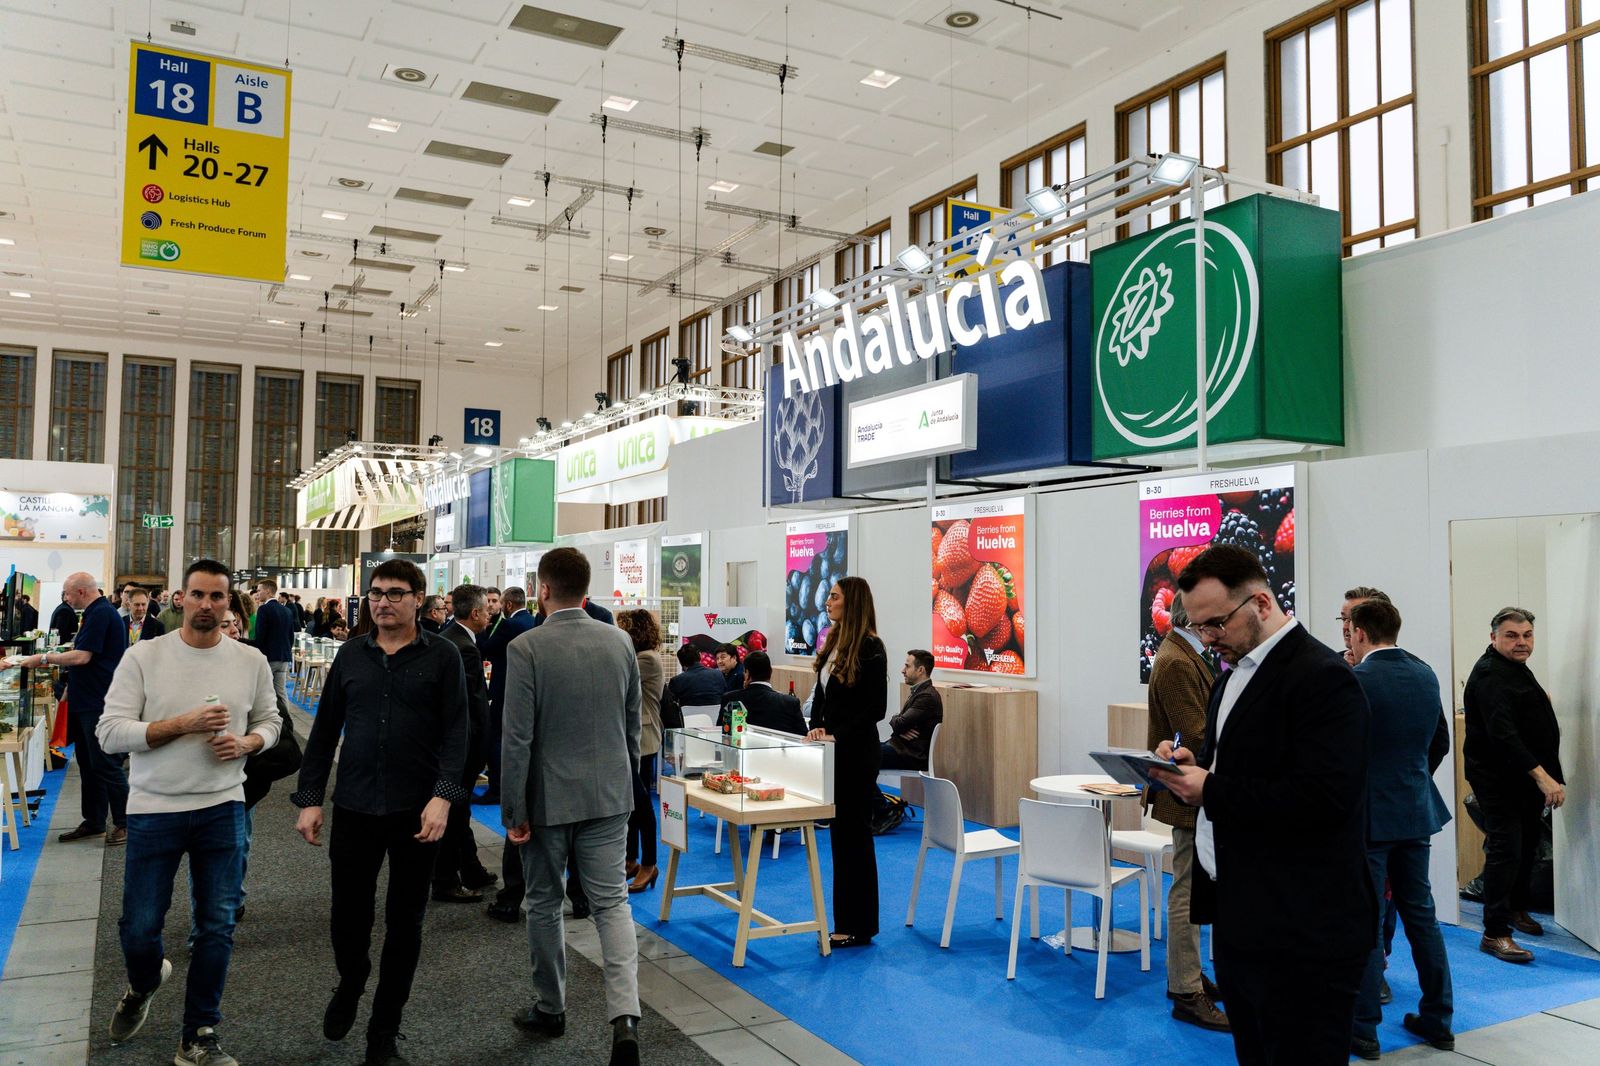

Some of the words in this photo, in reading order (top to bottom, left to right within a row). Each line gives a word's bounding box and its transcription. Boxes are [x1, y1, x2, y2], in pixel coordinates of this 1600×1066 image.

[160, 58, 188, 74] Hall
[235, 73, 269, 89] Aisle
[149, 79, 195, 114] 18
[237, 90, 263, 125] B
[184, 137, 220, 155] Halls
[168, 192, 209, 205] Logistics
[211, 198, 231, 208] Hub
[963, 210, 979, 221] Hall
[170, 218, 196, 230] Fresh
[198, 222, 236, 235] Produce
[237, 227, 267, 239] Forum
[782, 233, 1051, 400] Andalucía
[470, 416, 494, 438] 18
[857, 432, 876, 442] TRADE
[617, 431, 656, 470] unica
[566, 448, 597, 483] unica
[1146, 486, 1162, 495] B-30
[1210, 476, 1260, 489] FRESHUELVA
[19, 504, 31, 512] LA
[32, 505, 75, 513] MANCHA
[974, 504, 1004, 514] FRESHUELVA
[1149, 508, 1185, 520] Berries
[1186, 505, 1211, 518] from
[976, 526, 999, 535] Berries
[1000, 524, 1016, 534] from
[1149, 519, 1211, 539] Huelva
[976, 534, 1016, 550] Huelva
[790, 546, 815, 558] Huelva
[945, 645, 964, 655] Quality
[943, 655, 963, 666] Healthy
